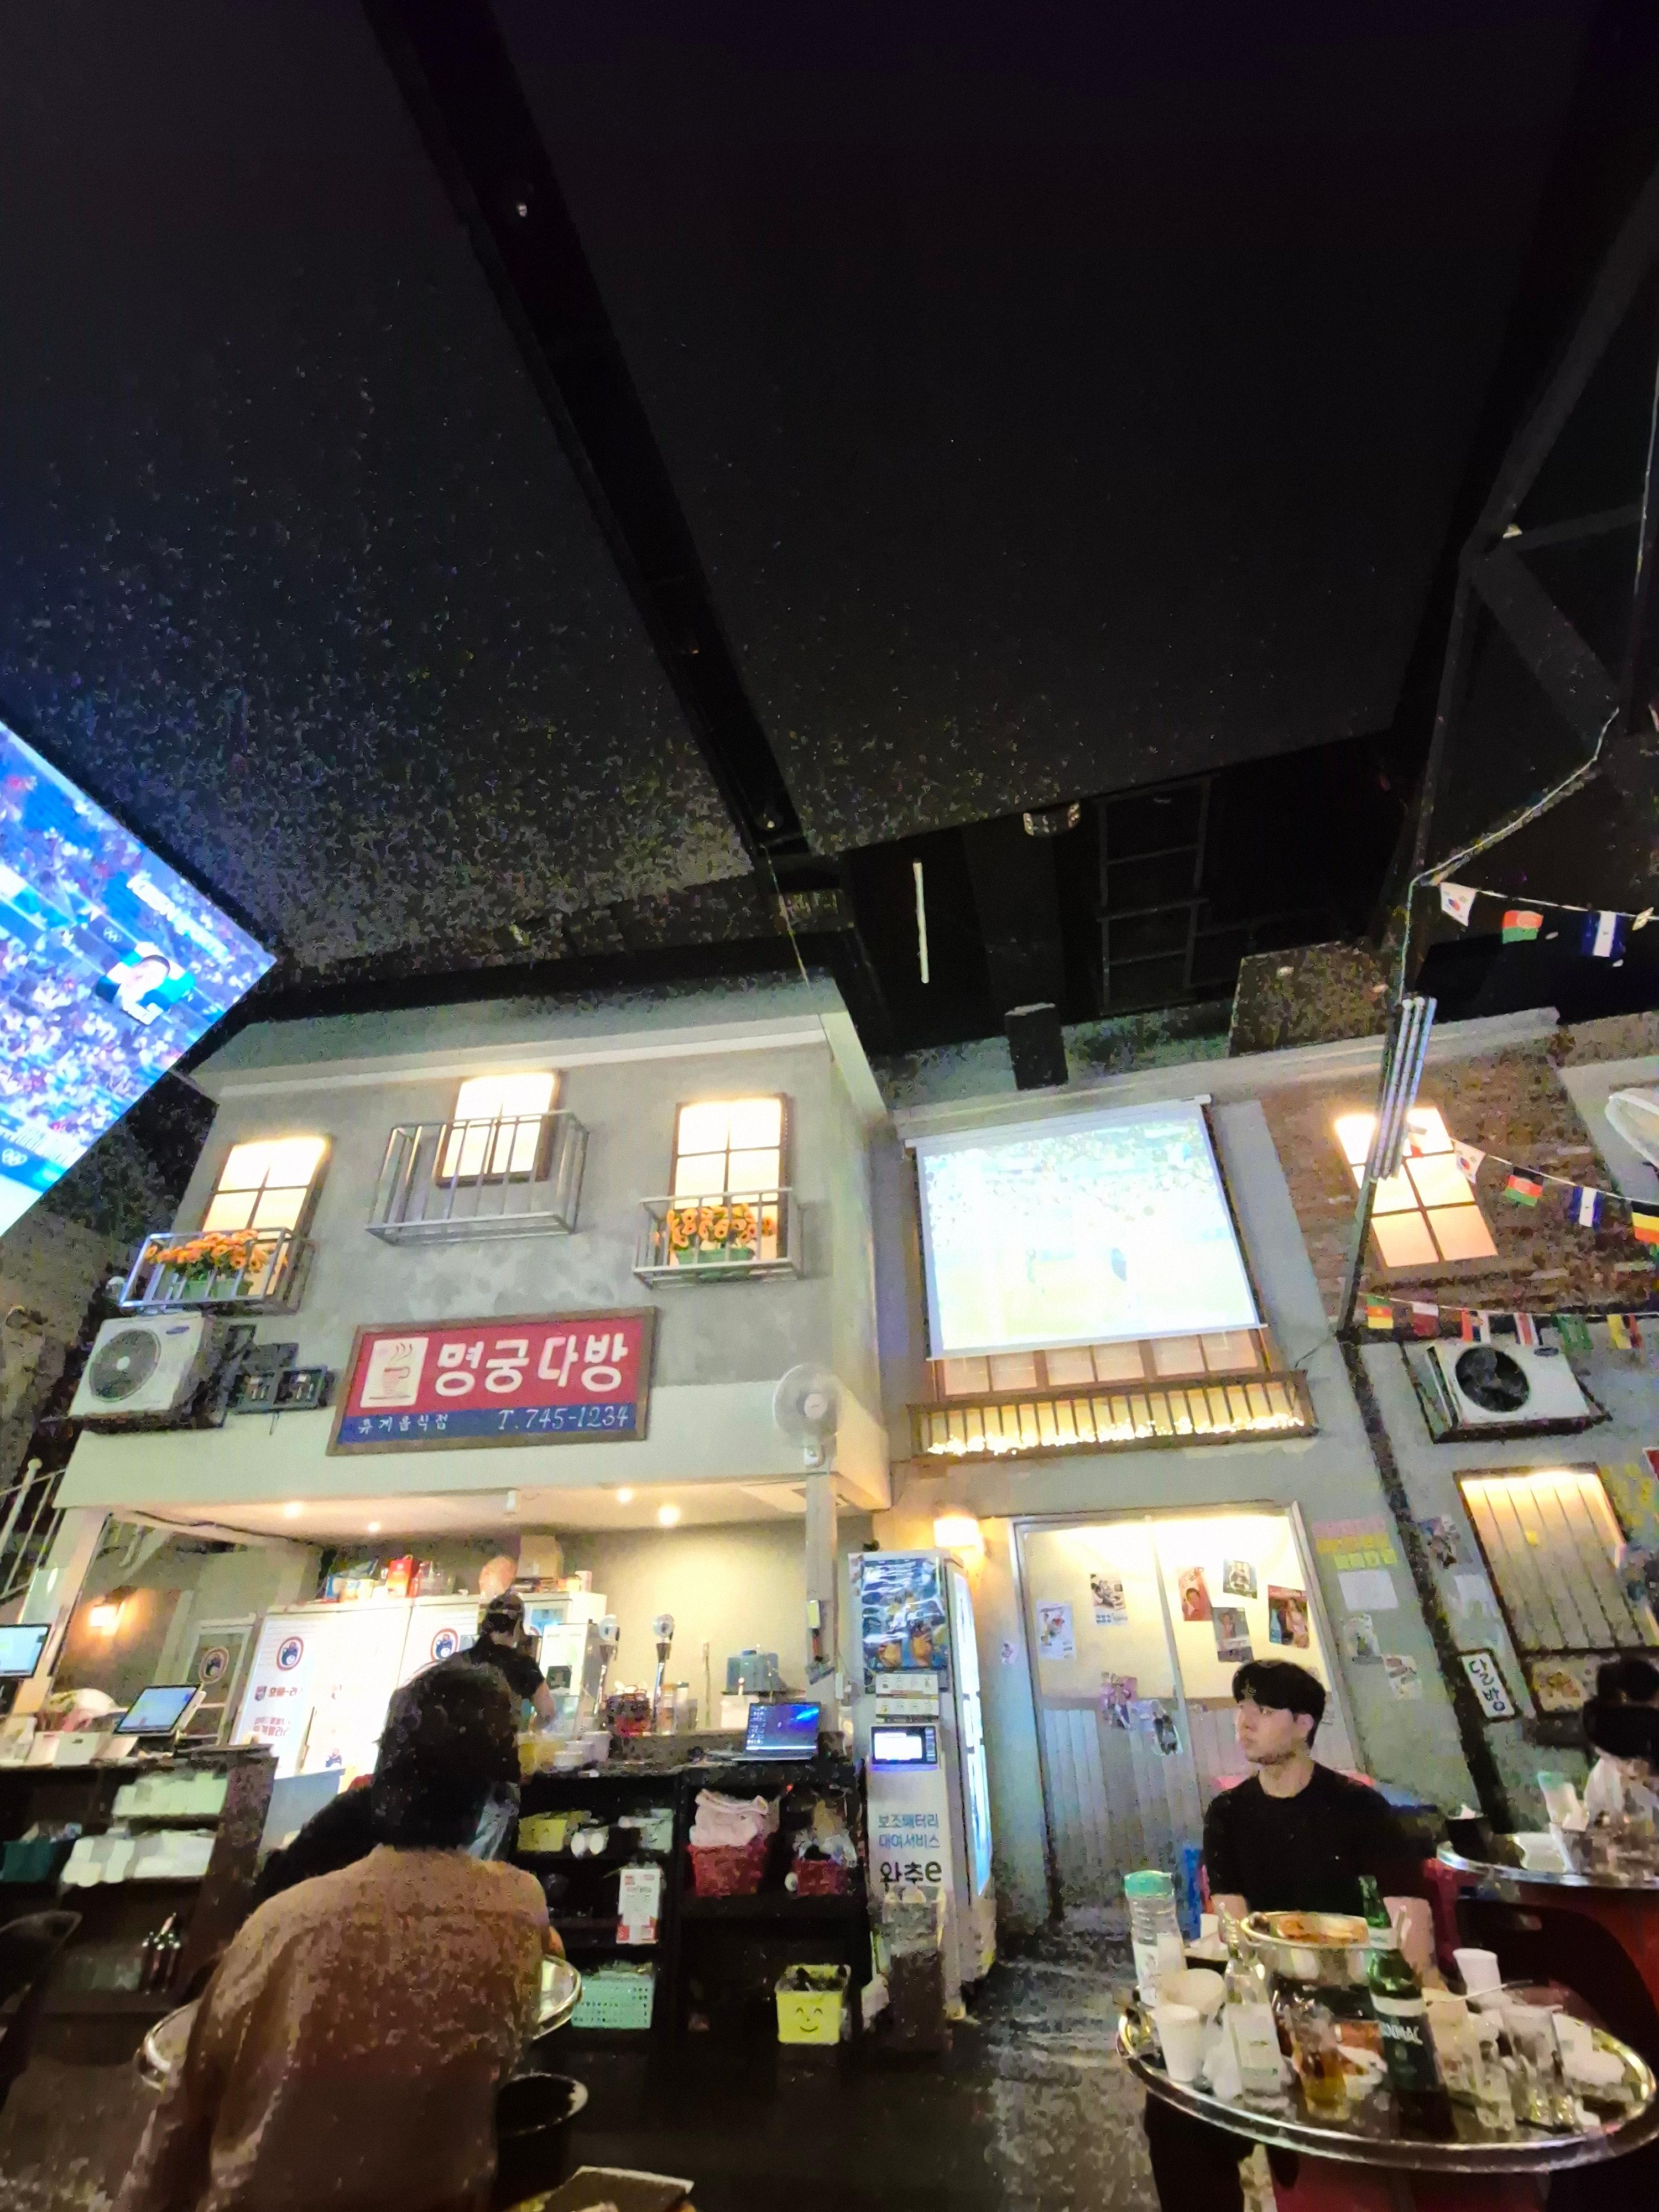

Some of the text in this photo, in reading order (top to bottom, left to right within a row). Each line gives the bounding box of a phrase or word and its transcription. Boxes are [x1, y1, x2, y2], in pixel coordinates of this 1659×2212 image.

[435, 1333, 628, 1396] 명궁다방
[526, 1405, 629, 1430] 745-1234
[878, 1833, 941, 1849] 대여서비스
